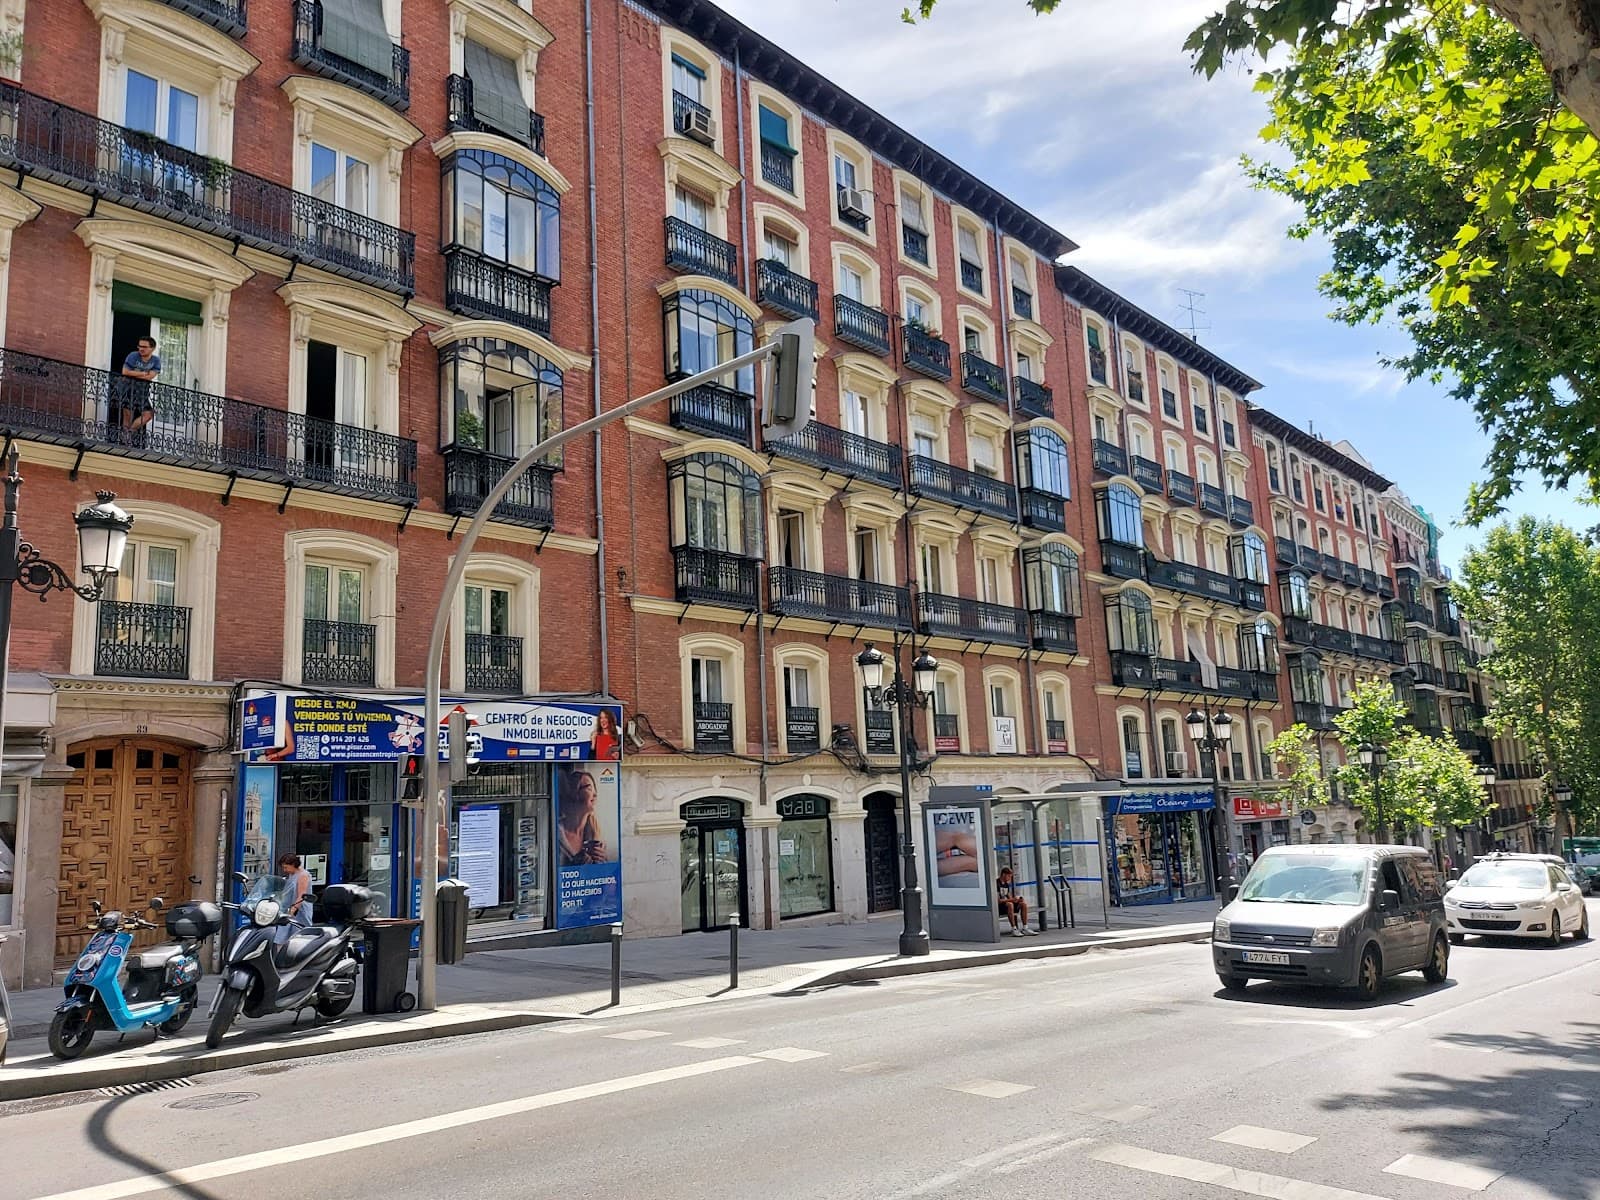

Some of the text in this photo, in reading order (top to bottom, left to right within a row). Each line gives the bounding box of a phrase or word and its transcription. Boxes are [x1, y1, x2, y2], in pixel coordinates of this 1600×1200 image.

[294, 699, 322, 709] DESDE
[324, 700, 334, 709] EL
[294, 710, 392, 722] VENDEMOS TÚ VIVIENDA
[485, 713, 593, 726] CENTRO de NEGOCIOS
[294, 722, 368, 733] ESTÉ DONDE ESTÉ
[503, 728, 578, 740] INMOBILIARIOS
[560, 871, 580, 879] TODO
[561, 880, 571, 889] LO
[571, 880, 585, 888] QUE
[561, 888, 602, 899] LO HACEMOS
[561, 900, 576, 908] POR
